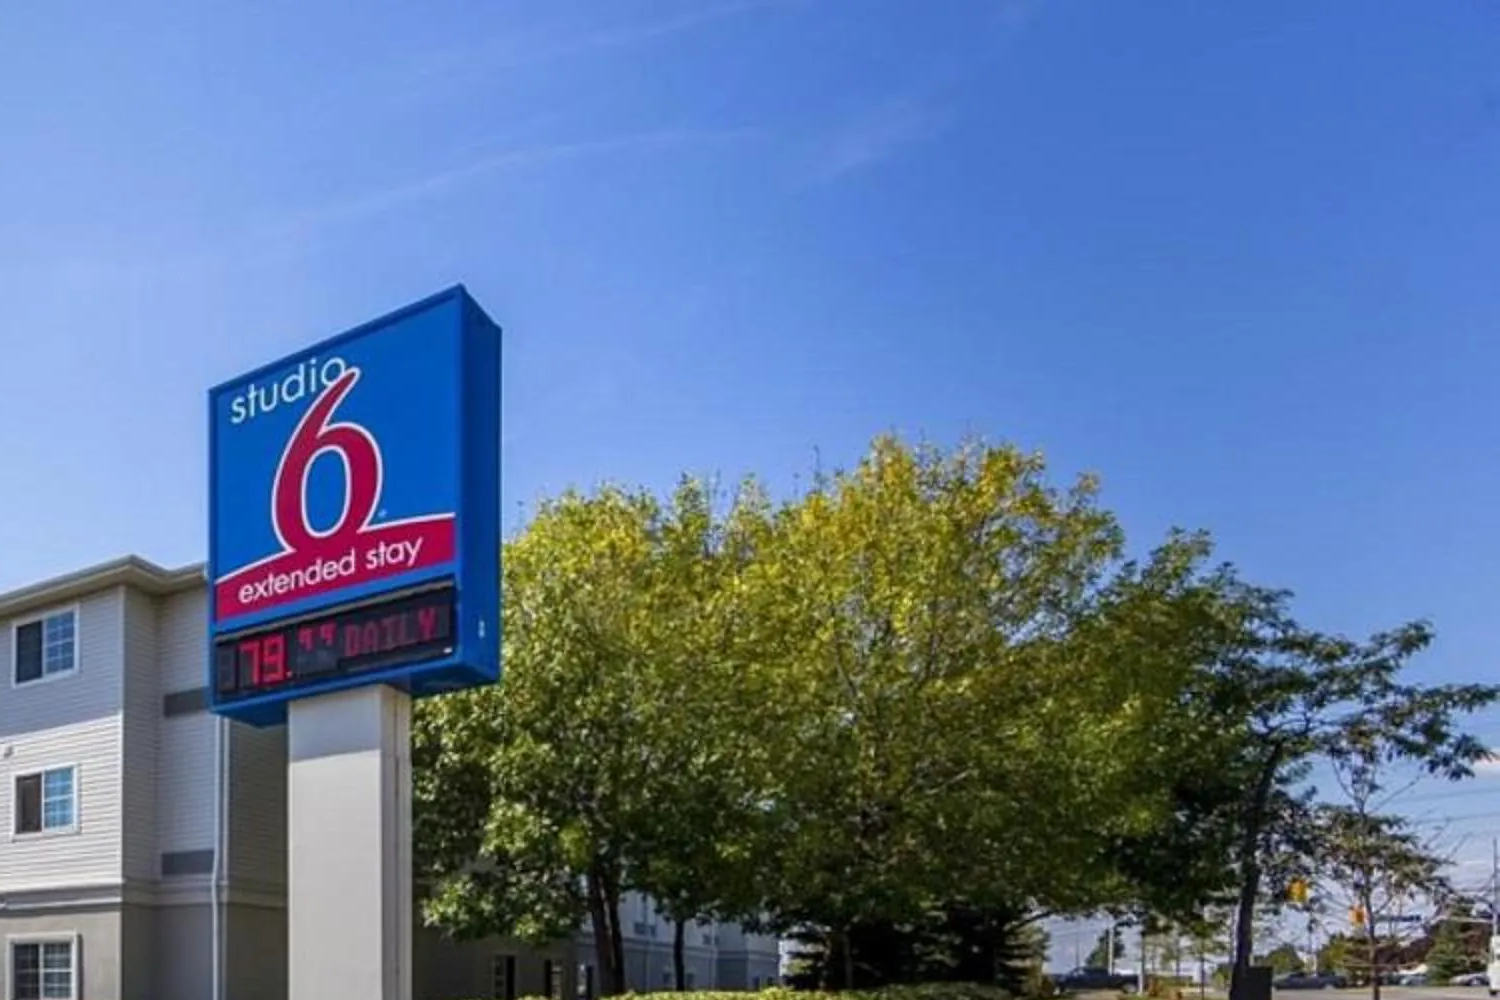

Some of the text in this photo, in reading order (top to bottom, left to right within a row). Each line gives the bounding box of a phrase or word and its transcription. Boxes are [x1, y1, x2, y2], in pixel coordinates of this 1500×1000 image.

[231, 357, 345, 424] studio
[272, 366, 383, 553] 6
[238, 537, 423, 604] extended stay
[345, 606, 437, 657] DAILY
